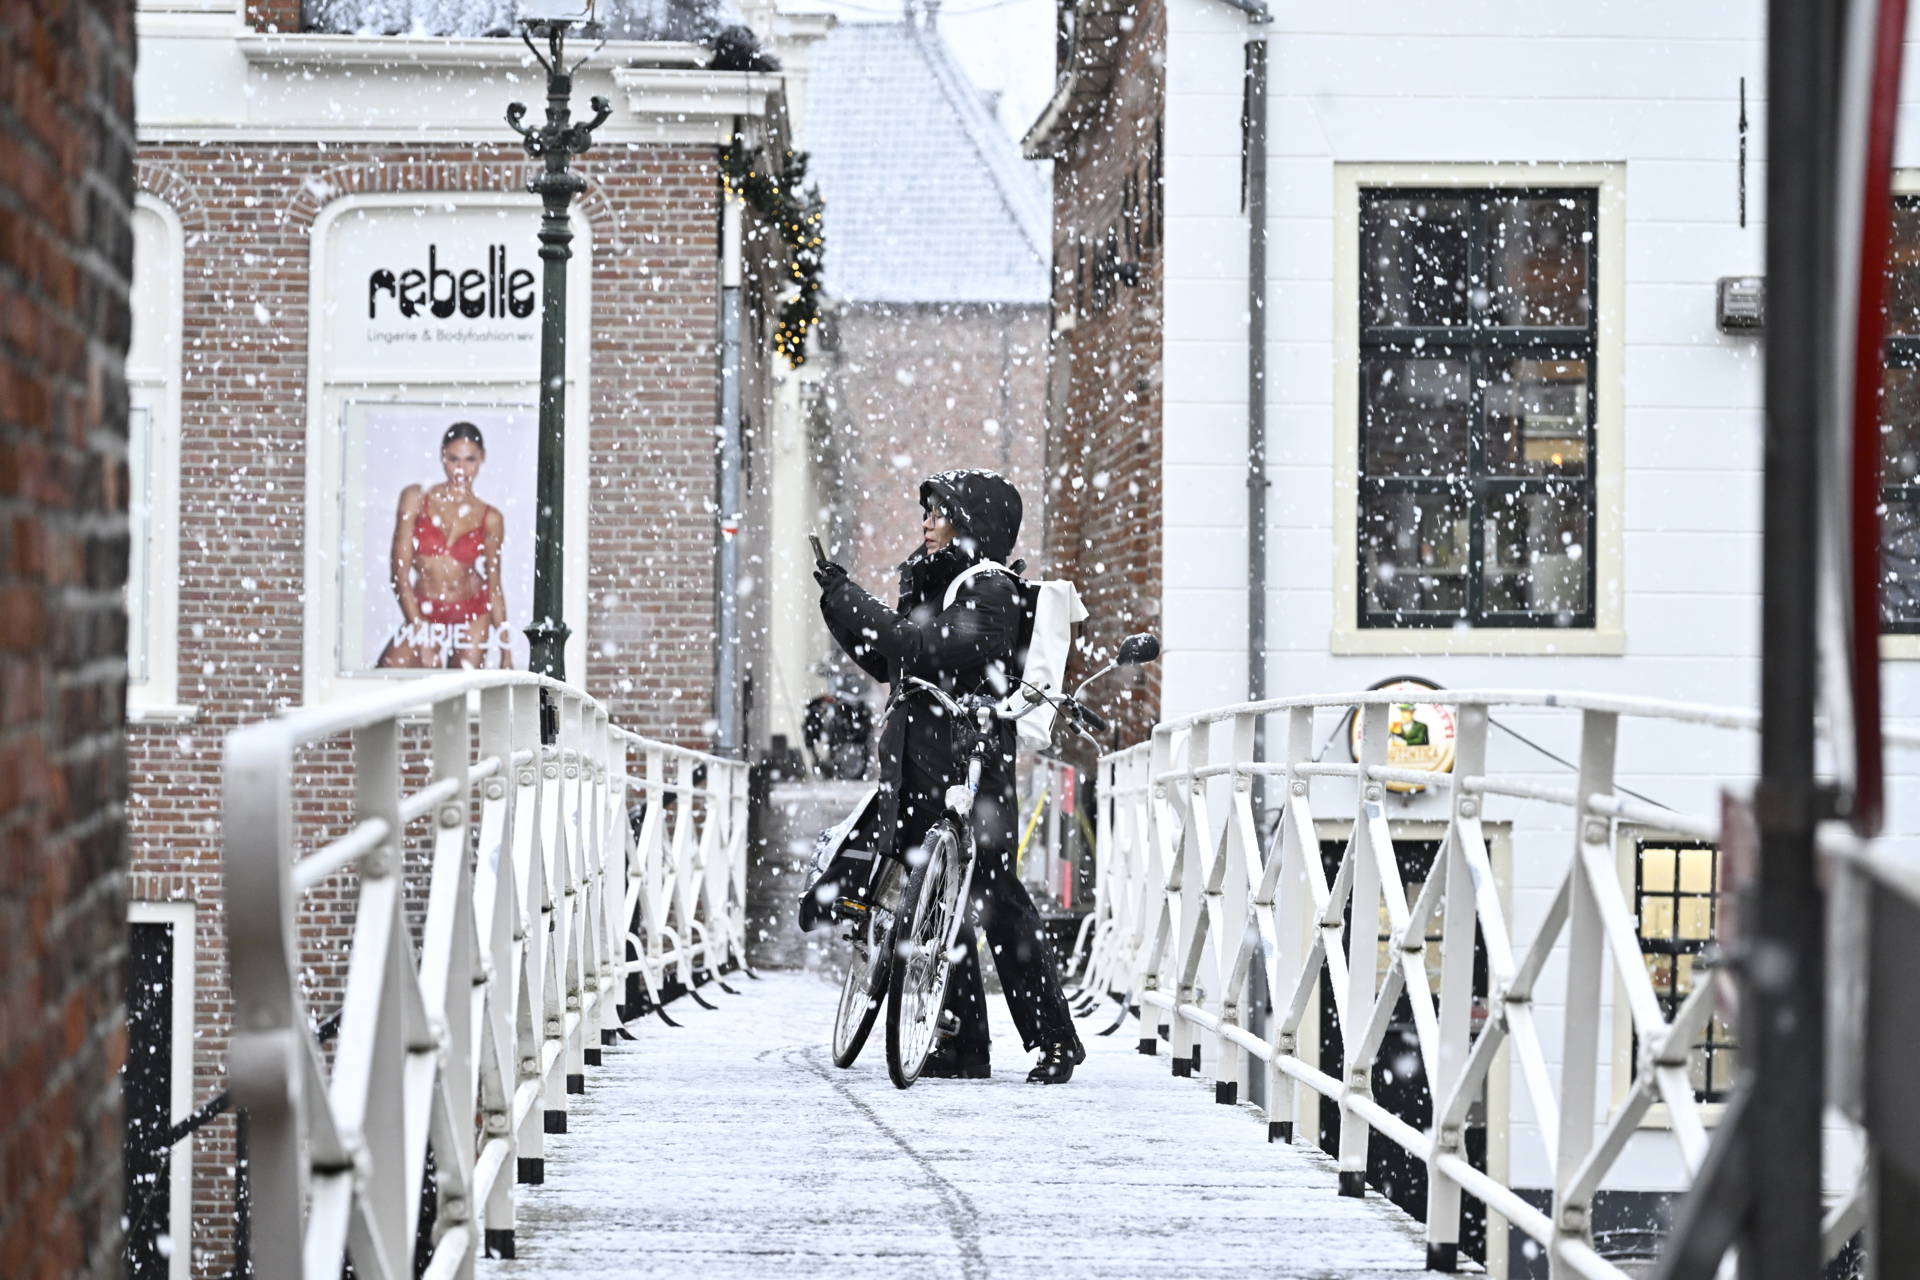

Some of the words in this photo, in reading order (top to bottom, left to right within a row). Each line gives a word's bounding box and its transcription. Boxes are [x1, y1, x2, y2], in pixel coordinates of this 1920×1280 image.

[369, 244, 535, 319] rebelle
[367, 327, 417, 344] Lingerie
[421, 328, 432, 341] &
[436, 327, 514, 344] Bodyfashion
[380, 624, 474, 648] MARIE
[478, 624, 519, 649] JO
